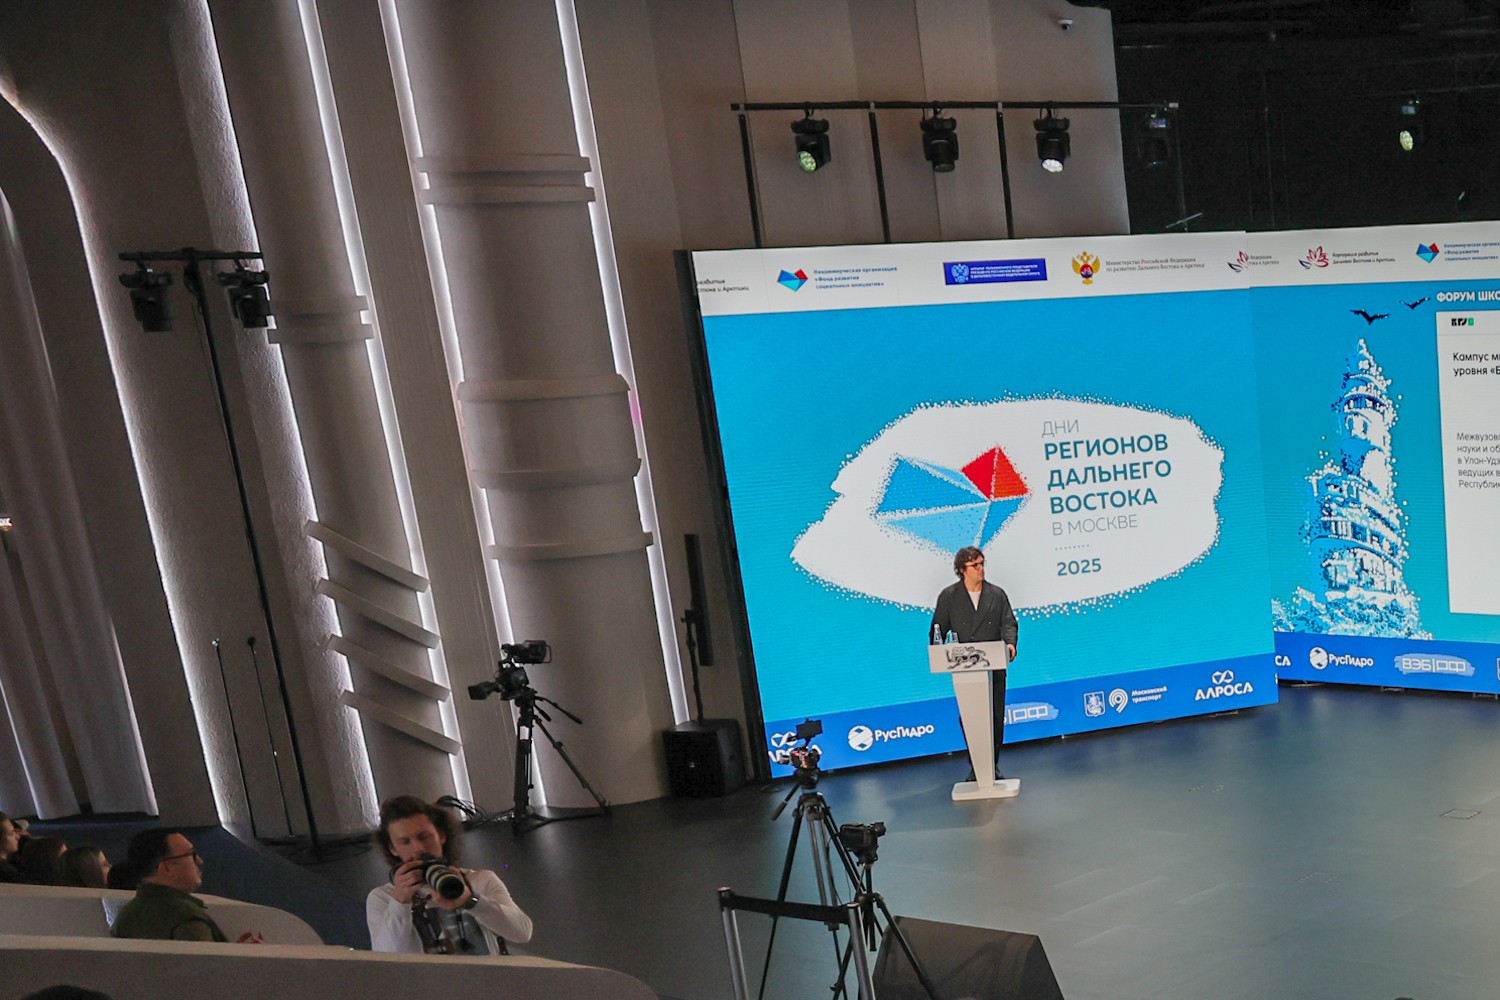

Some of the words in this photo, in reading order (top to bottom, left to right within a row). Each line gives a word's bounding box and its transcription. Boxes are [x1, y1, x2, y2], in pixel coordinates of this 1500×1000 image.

[1436, 290, 1476, 303] ФОРУМ
[1453, 351, 1489, 364] Кампус
[1453, 366, 1488, 377] уровня
[1041, 419, 1080, 439] ДНИ
[1044, 433, 1169, 461] РЕГИОНОВ
[1457, 445, 1481, 455] науки
[1463, 456, 1500, 467] Улан-Удэ
[1047, 459, 1172, 491] ДАЛЬНЕГО
[1458, 469, 1495, 479] ведущих
[1049, 487, 1158, 515] ВОСТОКА
[1052, 521, 1063, 536] В
[1067, 514, 1138, 535] МОСКВЕ
[1057, 557, 1102, 577] 2025
[1328, 653, 1374, 668] РусГидро
[1131, 685, 1168, 697] Московский
[1195, 681, 1254, 701] АЛРОСА
[1131, 694, 1163, 704] транспорт
[874, 723, 936, 744] РусГидро
